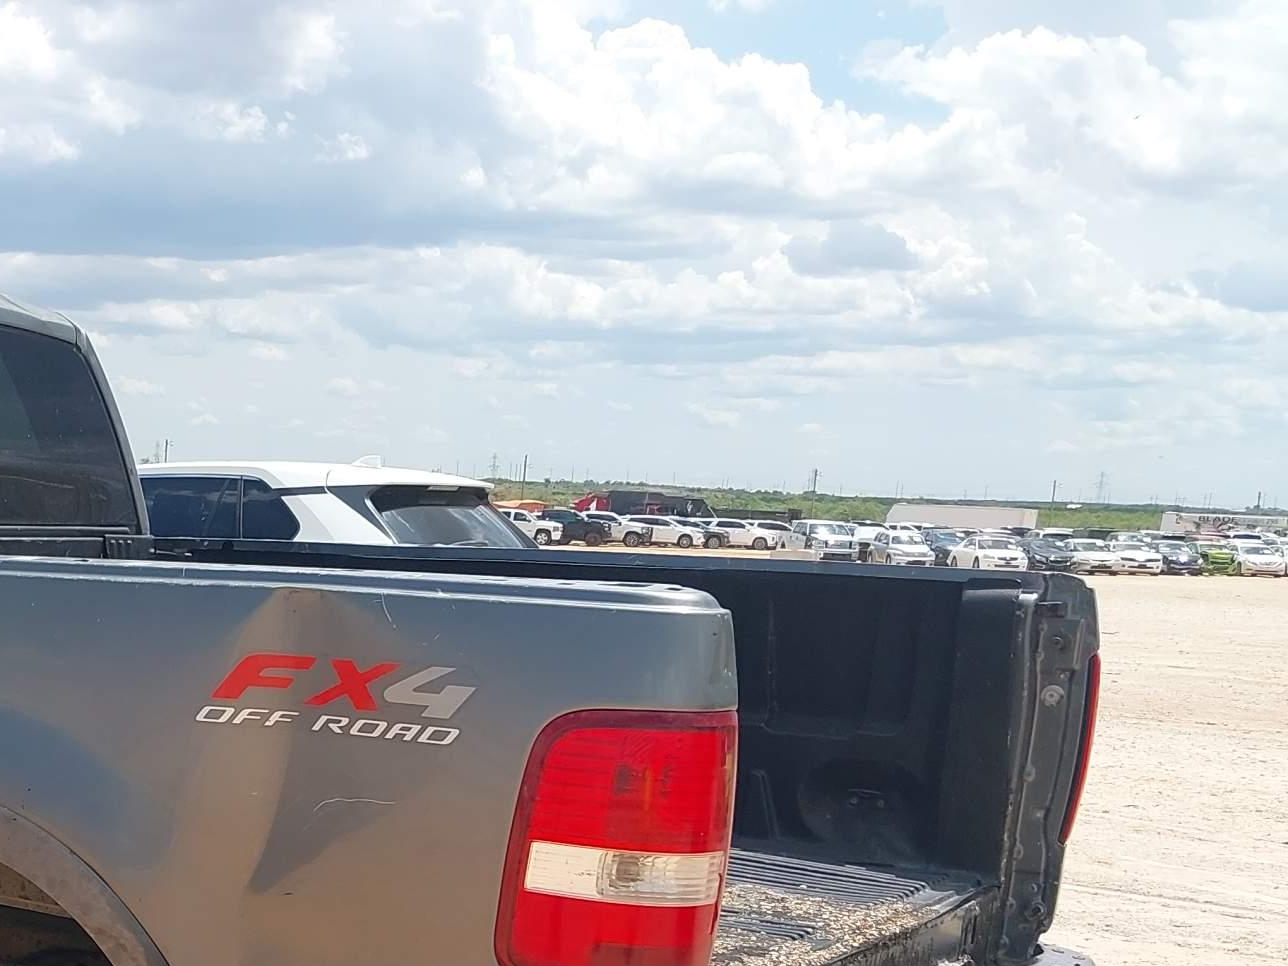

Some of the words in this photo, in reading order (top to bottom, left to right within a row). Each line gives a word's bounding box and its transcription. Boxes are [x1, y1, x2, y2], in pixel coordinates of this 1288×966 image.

[1198, 515, 1239, 523] BLADE
[211, 653, 477, 719] FX4
[194, 705, 300, 727] OFF
[311, 714, 460, 745] ROAD
